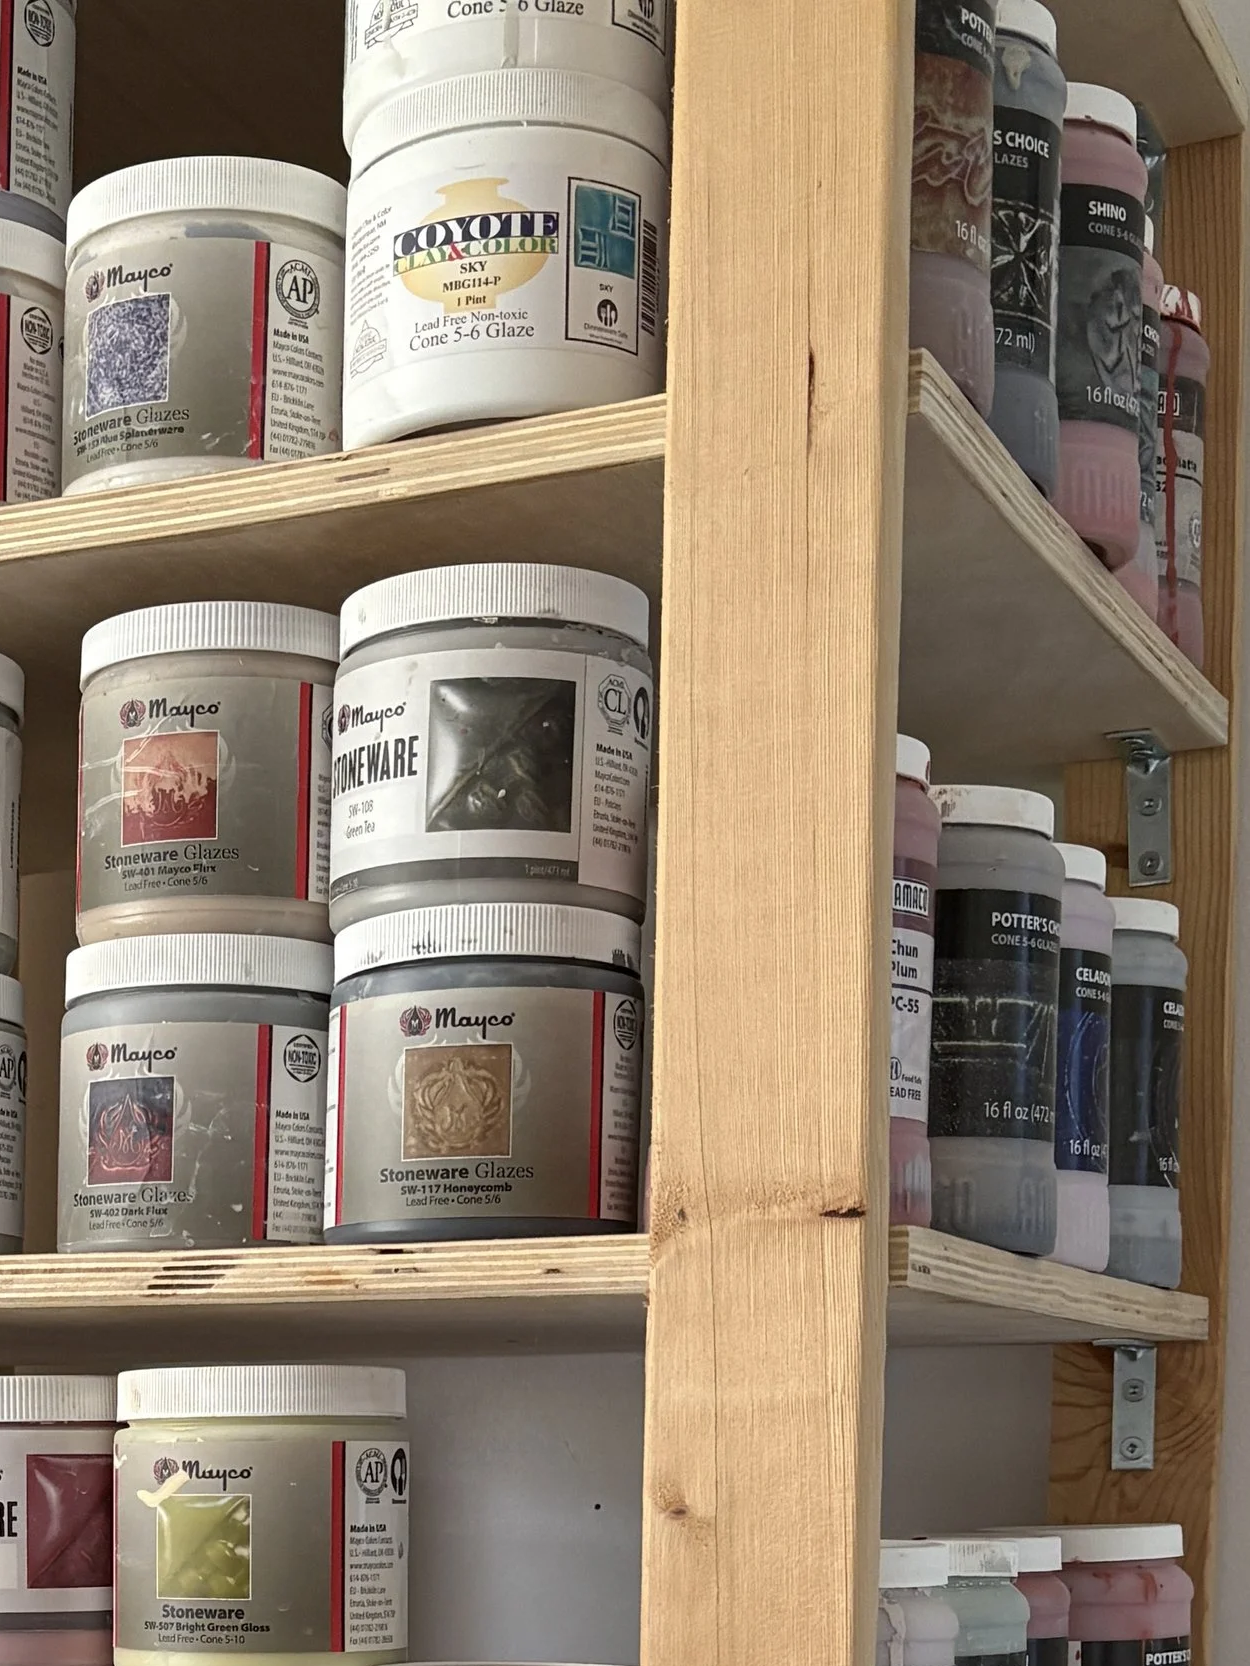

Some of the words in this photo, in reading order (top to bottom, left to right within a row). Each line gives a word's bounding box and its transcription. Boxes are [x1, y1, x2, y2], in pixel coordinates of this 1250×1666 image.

[1005, 131, 1050, 159] CHOICE
[1088, 200, 1127, 222] SHINO
[394, 213, 558, 259] COYOTE
[106, 263, 172, 292] Mayco
[460, 260, 487, 274] SKY
[286, 277, 314, 305] AP
[442, 276, 501, 292] MBG114-P
[465, 294, 486, 305] Pint
[415, 317, 440, 333] Lead
[441, 312, 467, 326] Free
[470, 308, 528, 322] Non-toxic
[409, 332, 449, 351] Cone
[453, 327, 481, 340] 5-6
[485, 323, 535, 339] Glaze
[136, 407, 190, 425] Glazes
[149, 698, 220, 728] Mayco
[603, 689, 627, 715] CL
[351, 702, 406, 733] Mayco
[104, 848, 179, 869] Stoneware
[183, 843, 240, 860] Glazes
[435, 1007, 514, 1039] Mayco
[0, 1057, 14, 1080] AP
[111, 1043, 177, 1073] Mayco
[984, 1102, 999, 1119] 16
[1002, 1102, 1011, 1121] fl
[1014, 1104, 1029, 1122] oz
[380, 1166, 469, 1183] Stoneware
[474, 1161, 534, 1180] Glazes
[73, 1192, 137, 1207] Stoneware
[400, 1184, 441, 1196] SW-117
[443, 1182, 512, 1194] Honeycomb
[405, 1196, 428, 1207] Lead
[429, 1195, 450, 1206] Free
[456, 1195, 482, 1206] Cone
[484, 1194, 502, 1205] 5/6
[183, 1460, 252, 1491] Mayco
[364, 1463, 383, 1482] AP
[162, 1604, 245, 1619] Stoneware
[176, 1622, 205, 1634] Bright
[207, 1622, 239, 1633] Green
[241, 1623, 271, 1633] Gloss
